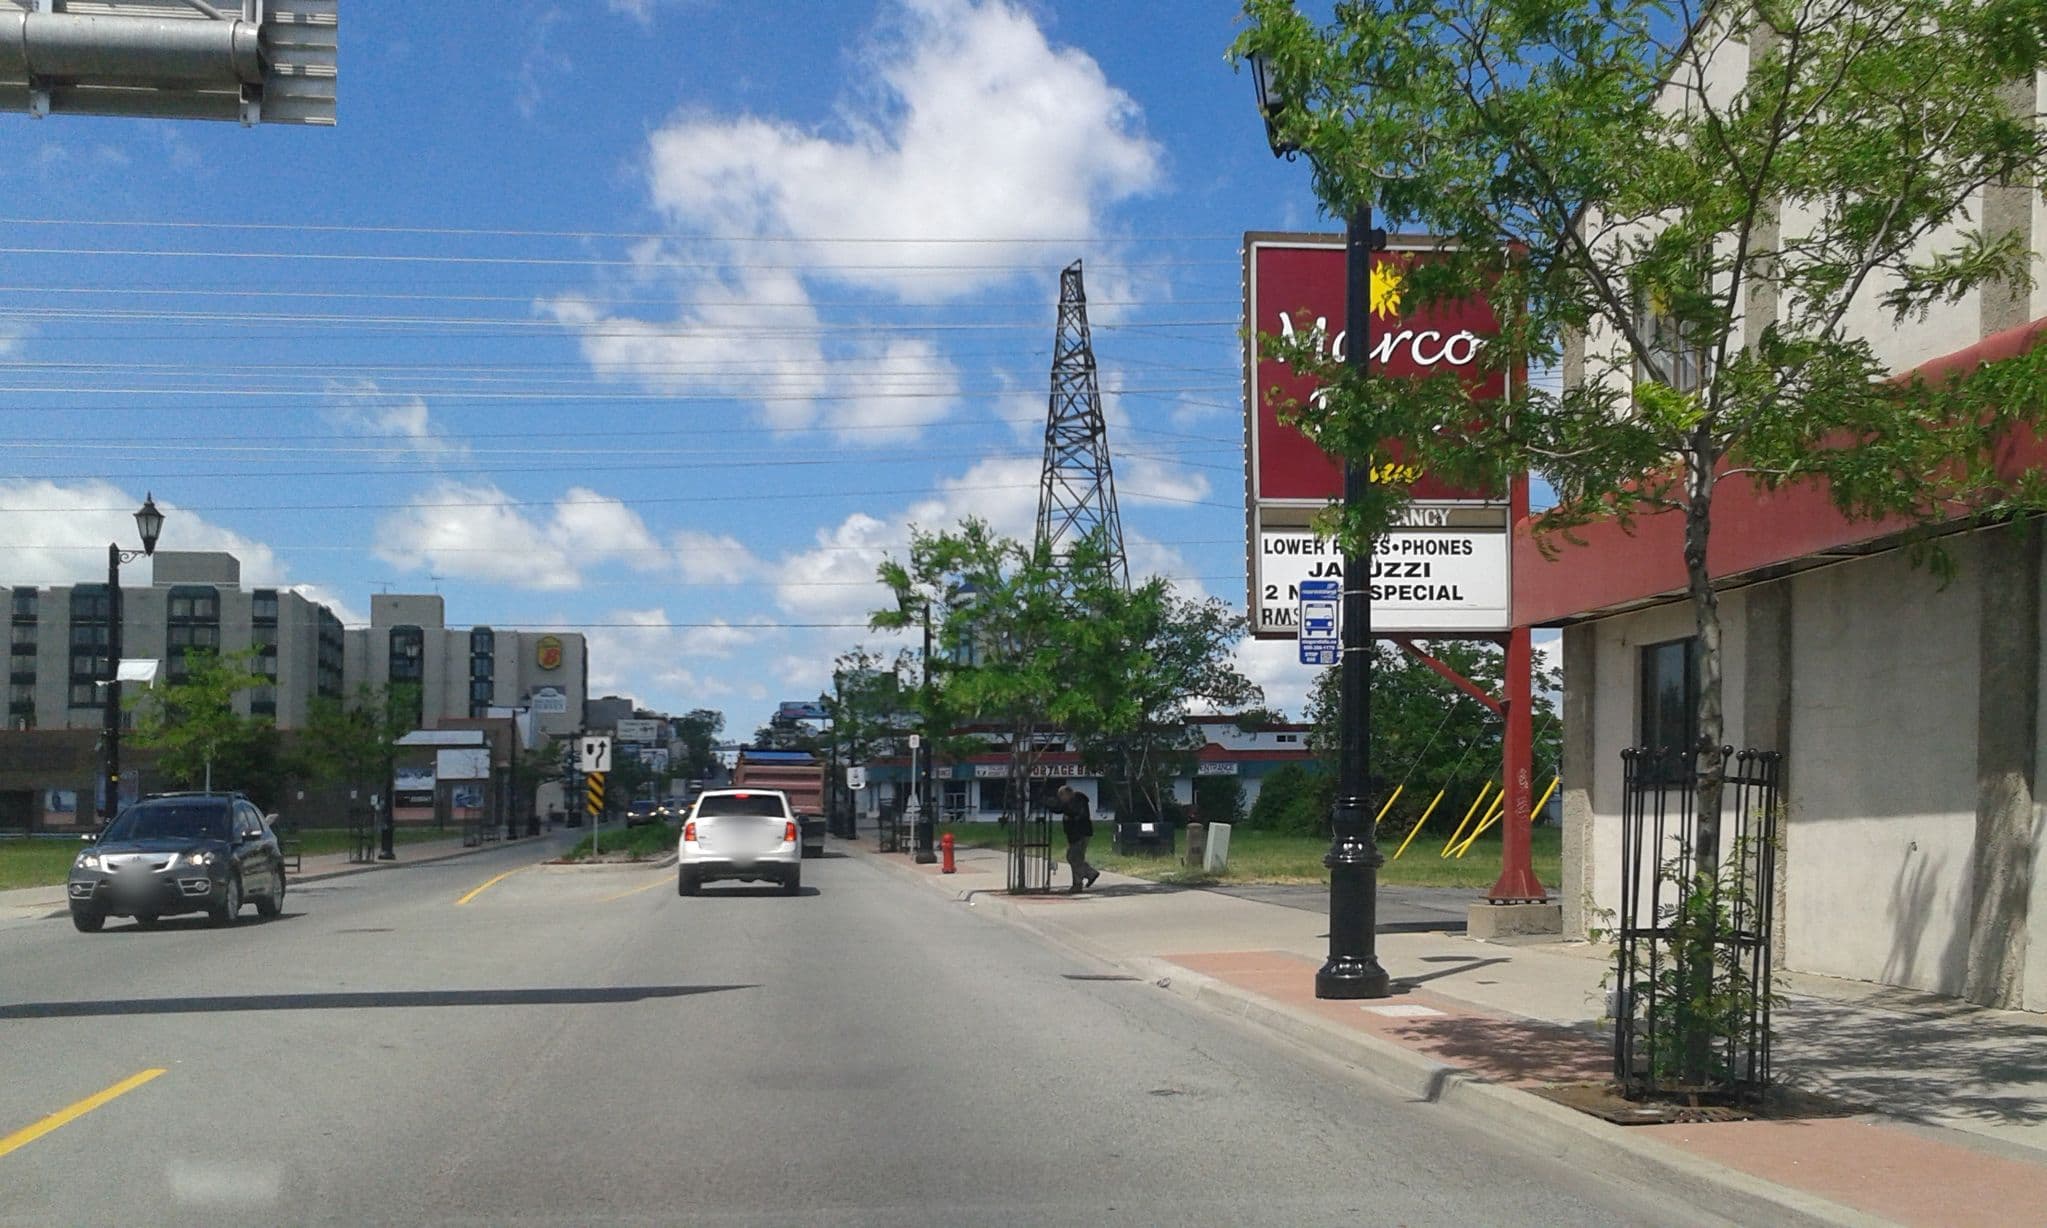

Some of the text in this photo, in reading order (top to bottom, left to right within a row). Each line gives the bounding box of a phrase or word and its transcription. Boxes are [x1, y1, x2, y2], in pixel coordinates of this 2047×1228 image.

[1387, 508, 1451, 526] ANCY
[1264, 538, 1325, 554] LOWER
[1308, 562, 1431, 578] JAUZZI
[1265, 584, 1279, 600] 2
[1369, 584, 1464, 601] SPECIAL
[1030, 764, 1075, 776] ORTAGE
